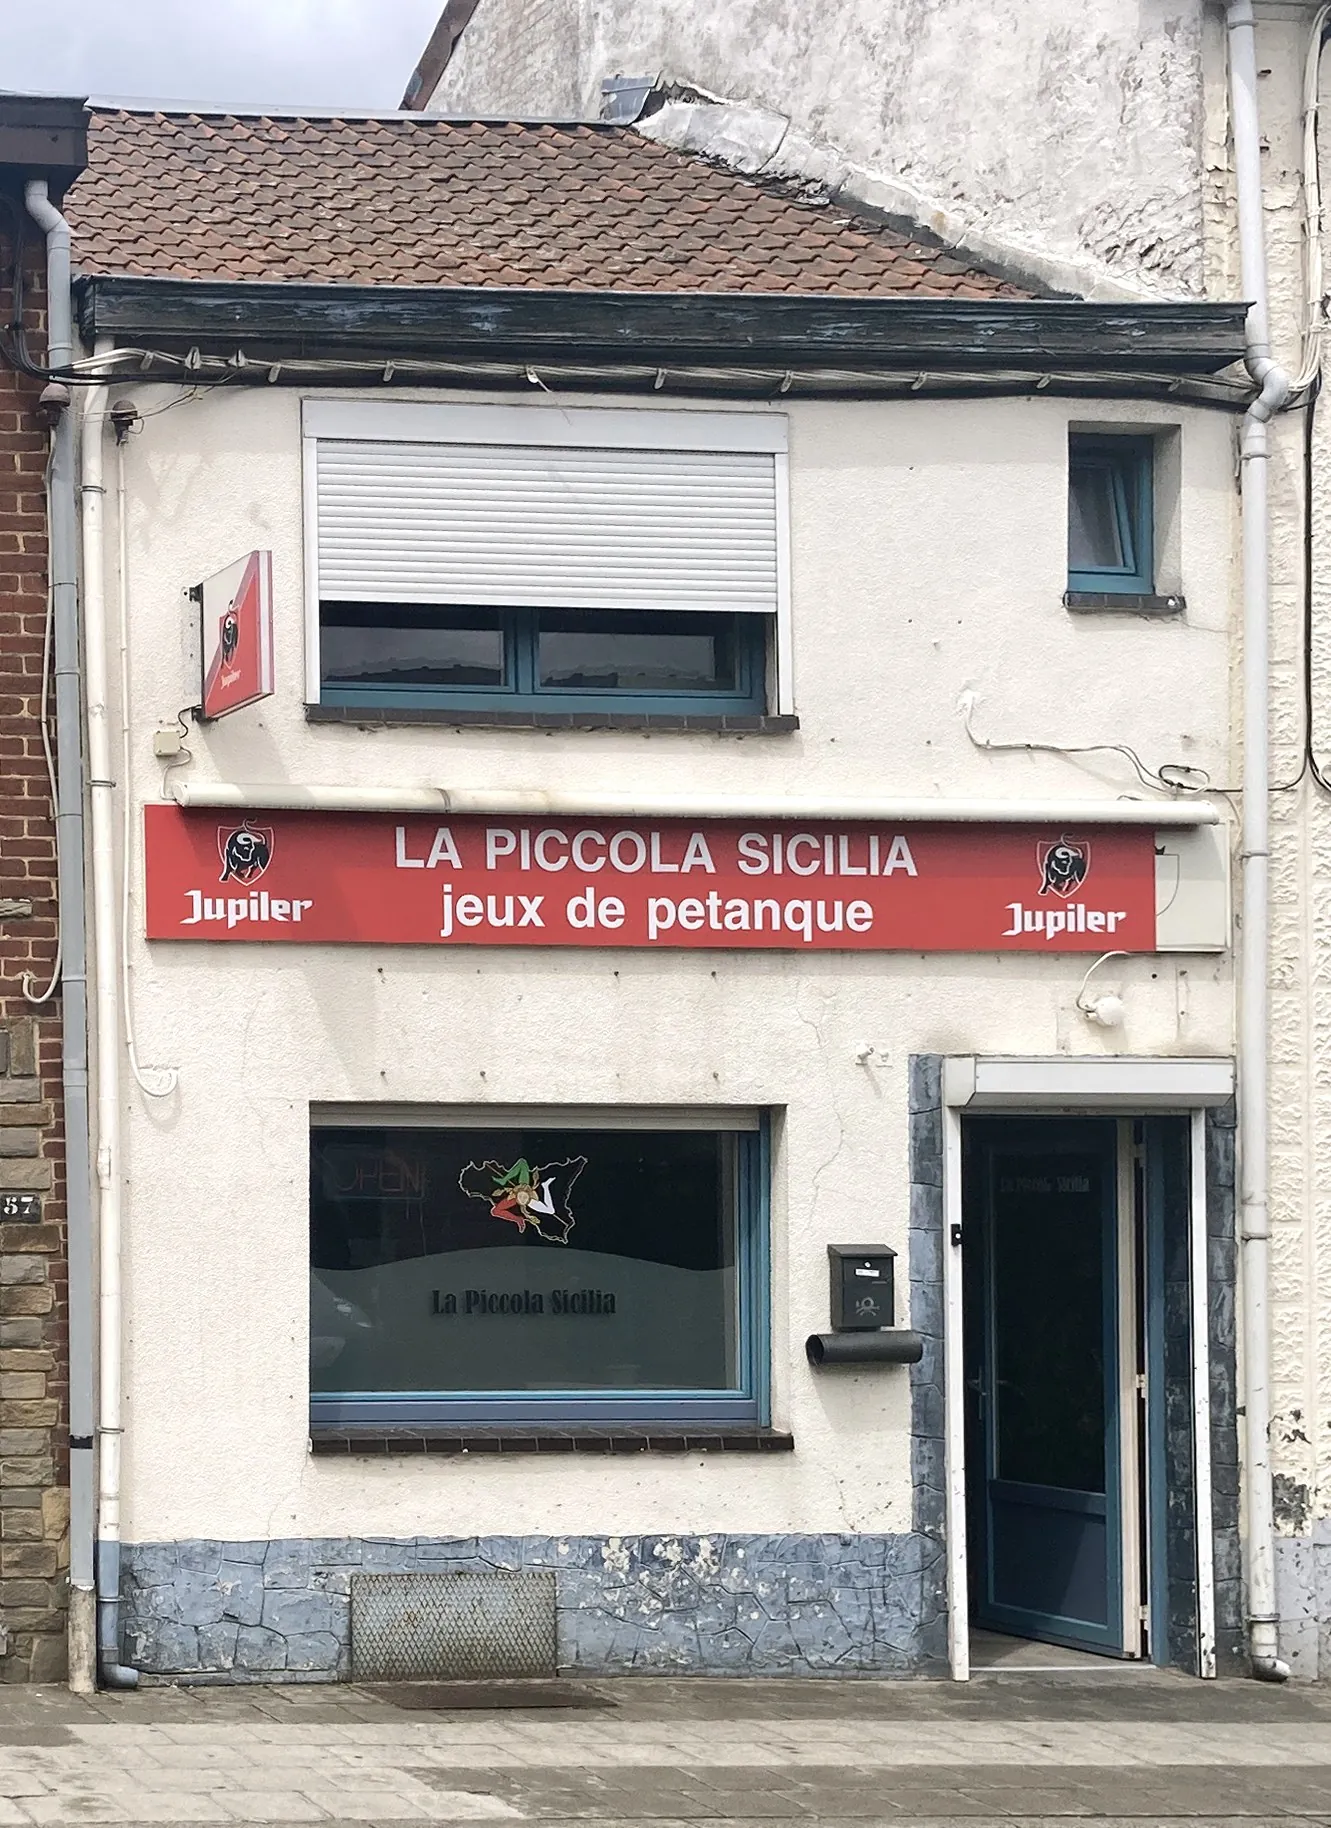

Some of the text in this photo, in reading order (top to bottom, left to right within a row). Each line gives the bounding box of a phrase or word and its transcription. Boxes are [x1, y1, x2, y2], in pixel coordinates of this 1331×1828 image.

[395, 826, 919, 878] LA PICCOLA SICILIA
[179, 889, 314, 930] Jupiler
[440, 883, 875, 942] jeux de petanque
[1001, 902, 1128, 941] Jupiler
[3, 1196, 34, 1215] 57
[431, 1289, 617, 1315] La Piccola Sicilia
